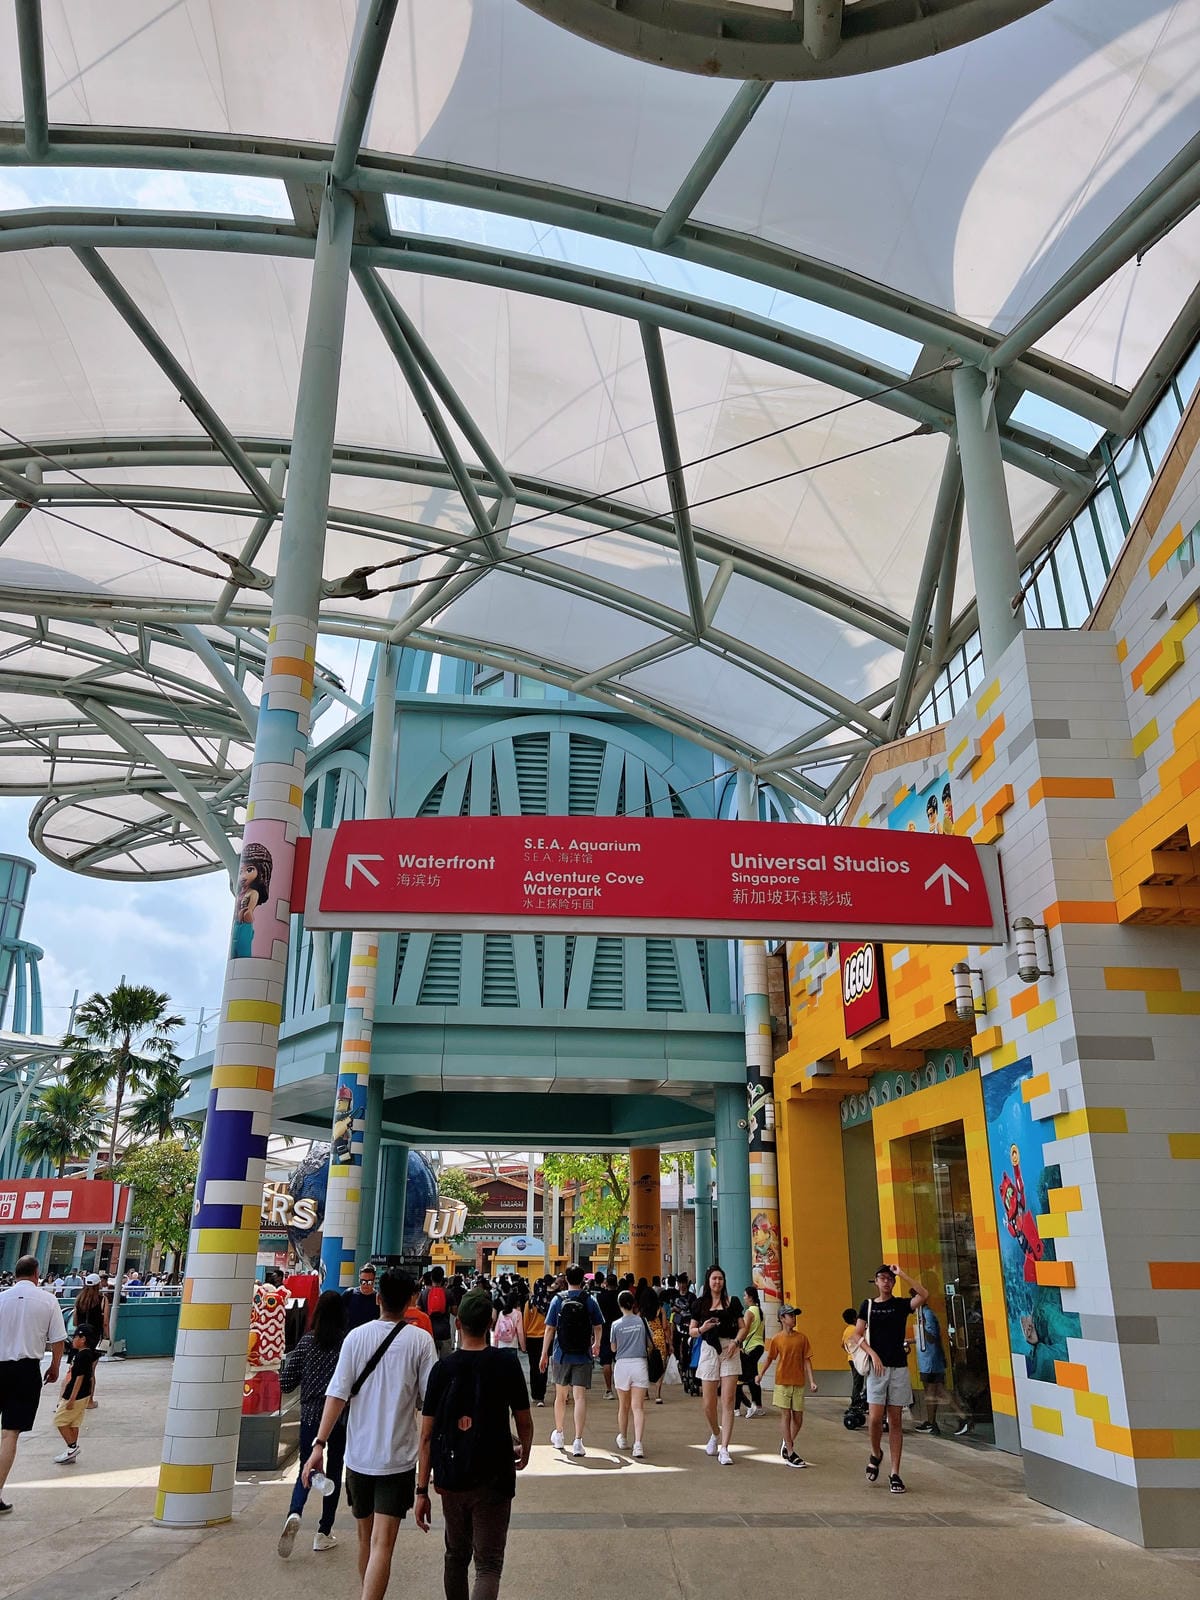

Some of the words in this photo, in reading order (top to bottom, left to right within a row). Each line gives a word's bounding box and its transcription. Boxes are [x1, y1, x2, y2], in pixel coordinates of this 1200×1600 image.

[524, 838, 565, 850] S.E.A.
[569, 839, 641, 854] Aquarium
[398, 854, 496, 870] Waterfront
[558, 852, 593, 864] 海洋馆
[730, 852, 827, 872] Universal
[833, 855, 910, 874] Studios
[396, 873, 441, 887] 海滨坊
[524, 870, 601, 885] Adventure
[605, 872, 645, 885] Cove
[732, 872, 800, 886] Singapore
[524, 883, 602, 898] Waterpark
[732, 888, 853, 907] 新加坡环球影城
[522, 898, 594, 911] 水上探险乐园
[844, 943, 874, 1006] LEGO
[493, 1222, 513, 1230] FOOD
